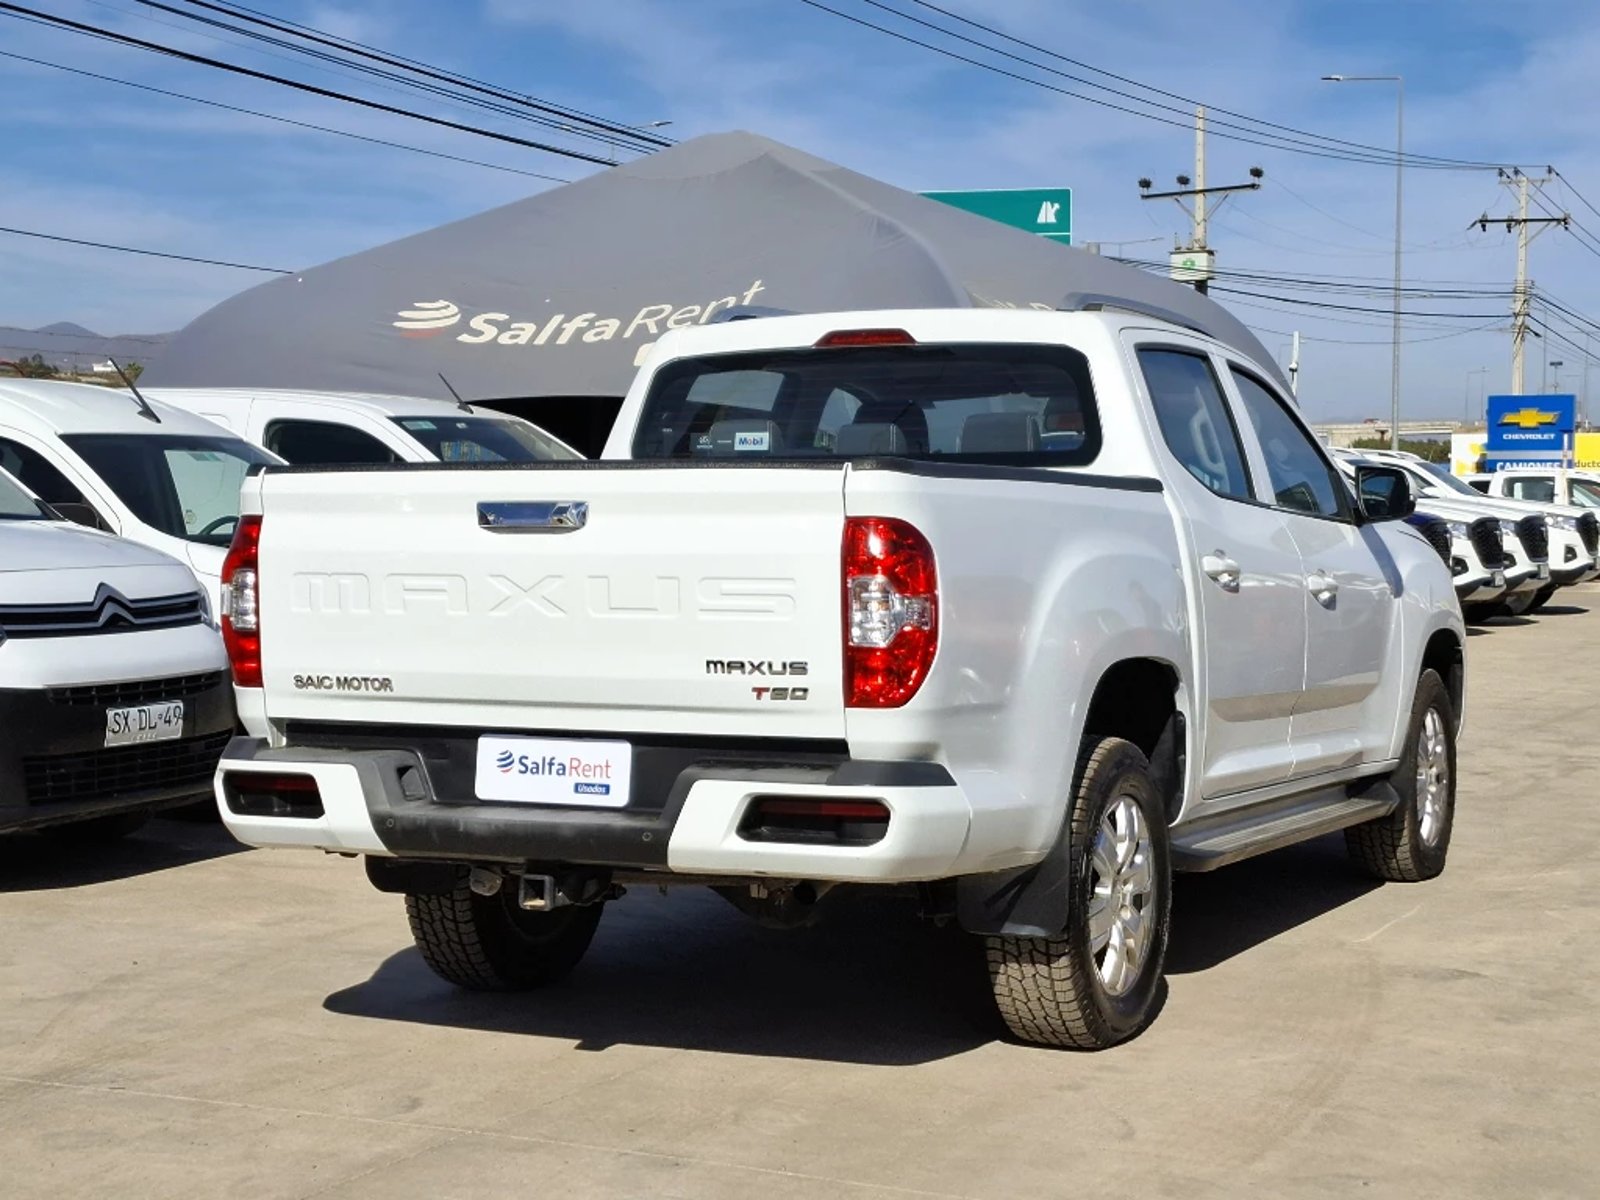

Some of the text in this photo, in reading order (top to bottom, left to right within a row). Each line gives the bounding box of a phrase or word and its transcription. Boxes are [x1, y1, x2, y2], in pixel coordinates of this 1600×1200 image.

[739, 437, 763, 446] Mobil
[291, 572, 797, 621] MAXUS
[706, 659, 808, 675] MAXUS
[293, 674, 394, 692] SAIC MOTOR
[518, 755, 612, 779] SalfaRent
